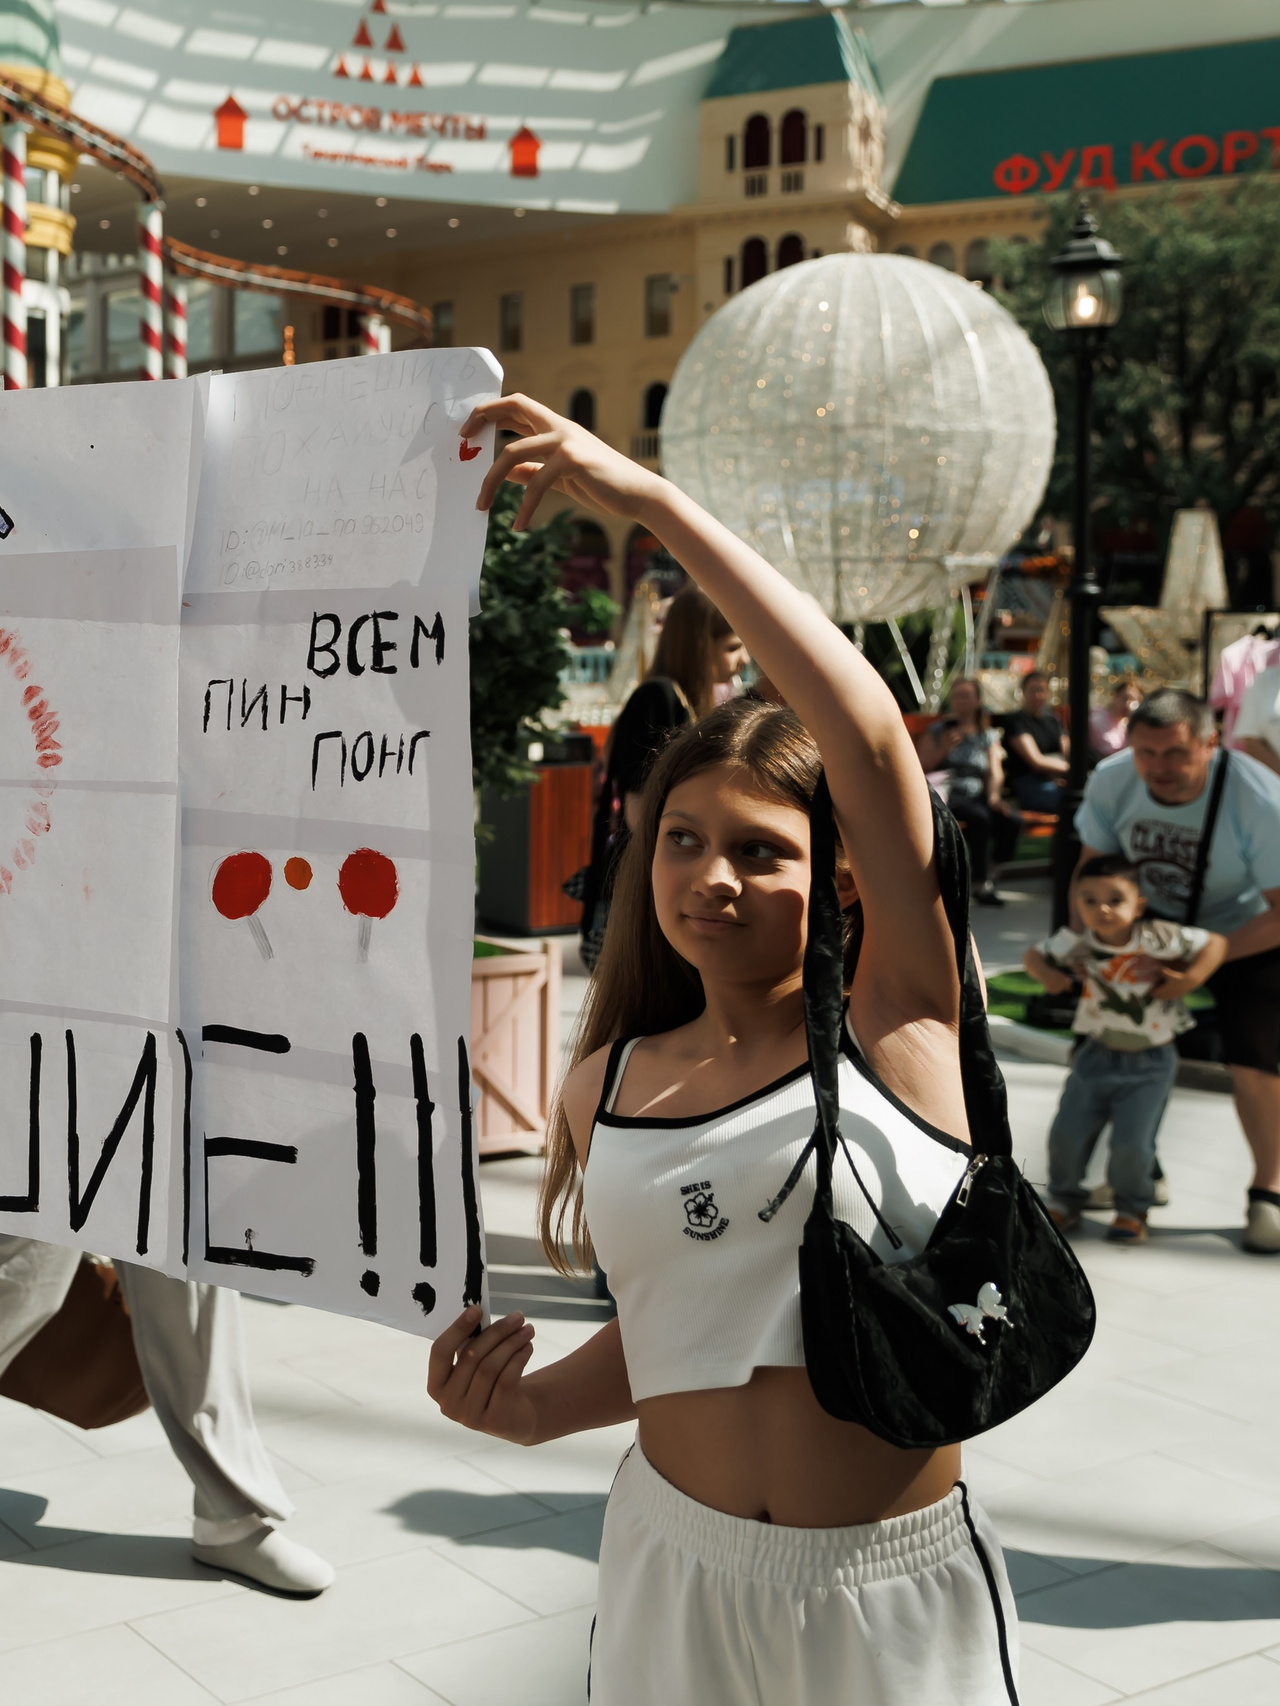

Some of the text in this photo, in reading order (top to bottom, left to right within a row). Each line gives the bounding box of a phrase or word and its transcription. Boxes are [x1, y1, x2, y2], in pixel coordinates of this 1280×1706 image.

[271, 96, 487, 140] ОСТРОВ МЕЧТЫ
[993, 126, 1280, 196] ФУД КОРТ
[303, 467, 428, 506] НА НАС
[306, 609, 446, 679] ВСЕМ
[203, 678, 311, 733] ПИН
[311, 730, 431, 791] ПОНГ
[680, 1181, 711, 1195] SHE IS
[683, 1218, 730, 1241] SUNSHINE
